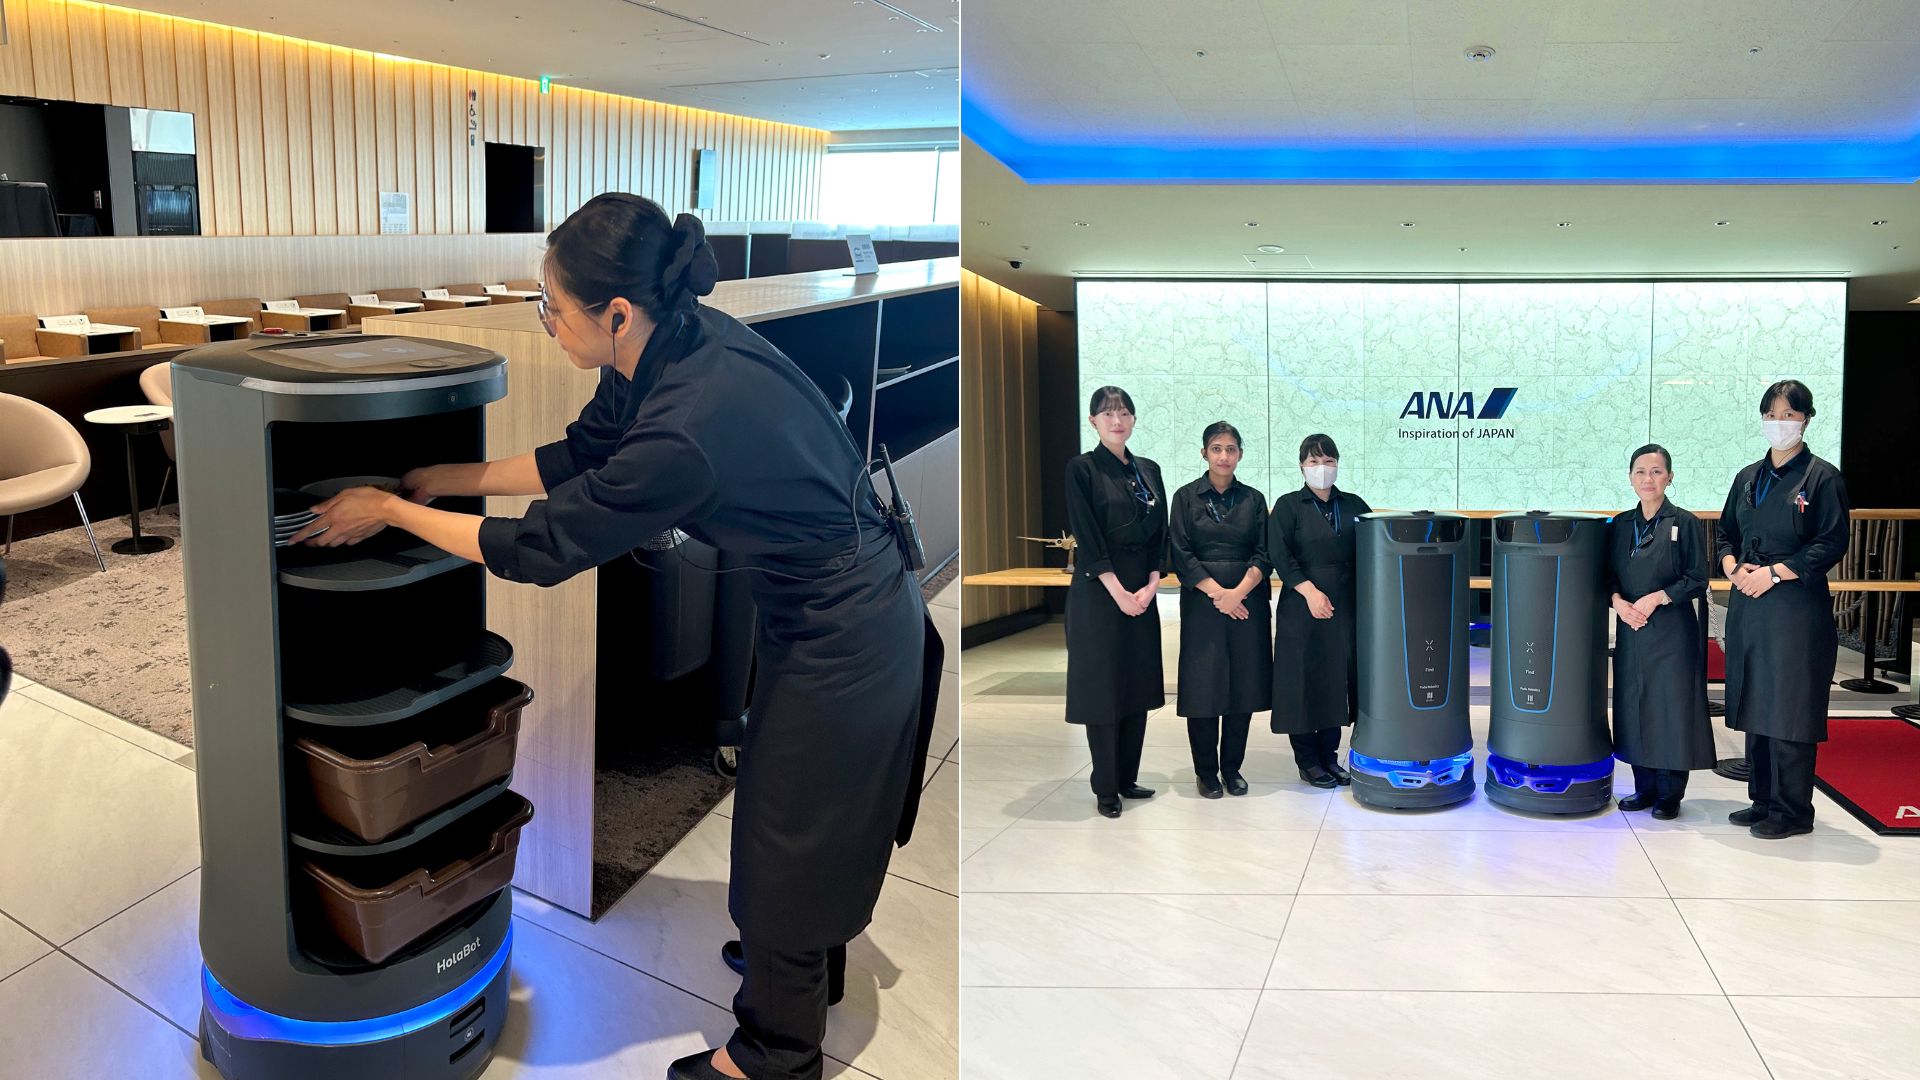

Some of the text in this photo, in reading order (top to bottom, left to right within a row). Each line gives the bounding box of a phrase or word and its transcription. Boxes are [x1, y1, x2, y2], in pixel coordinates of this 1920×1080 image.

[1399, 391, 1475, 420] ANA
[1398, 428, 1515, 441] Inspiration of JAPAN
[436, 936, 481, 974] HolaBot
